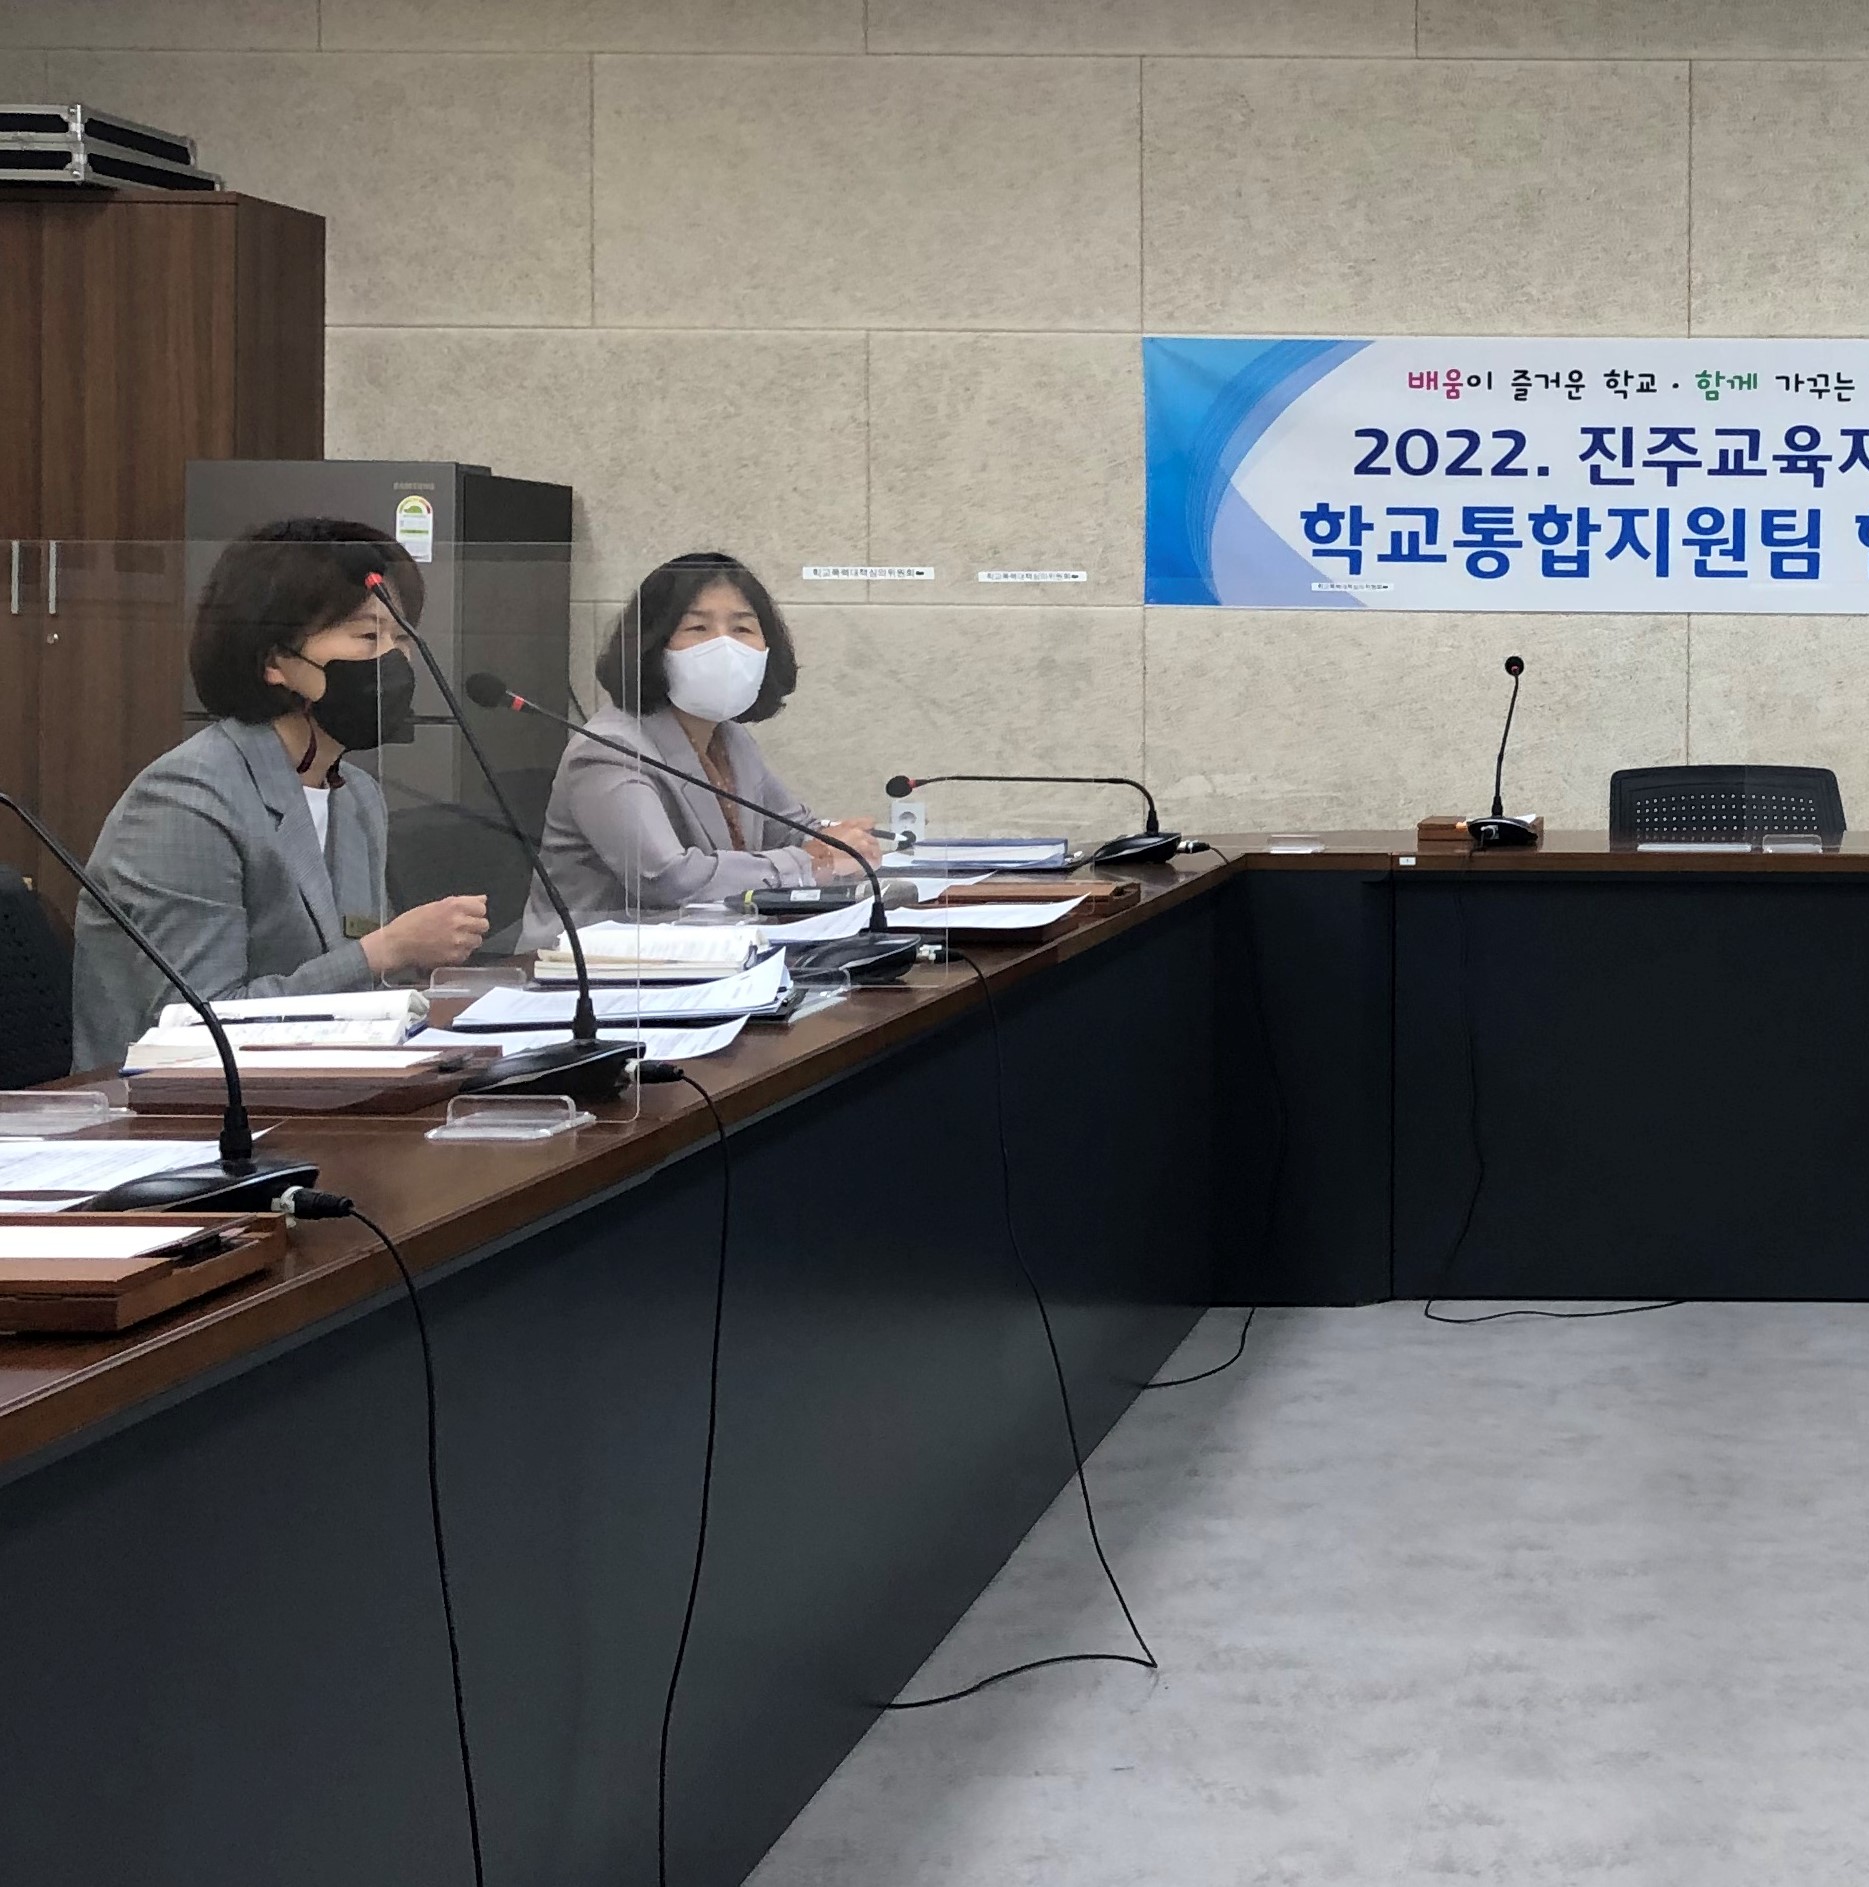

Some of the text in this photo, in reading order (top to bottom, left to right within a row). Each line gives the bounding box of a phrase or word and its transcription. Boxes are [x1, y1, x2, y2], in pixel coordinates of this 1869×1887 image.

[1408, 368, 1493, 400] 배움이
[1510, 369, 1586, 402] 즐거운
[1603, 368, 1658, 400] 학교
[1694, 369, 1758, 401] 함께
[1774, 371, 1856, 403] 가꾸는
[1353, 427, 1550, 478] 2022.
[1299, 502, 1821, 580] 학교통합지원팀
